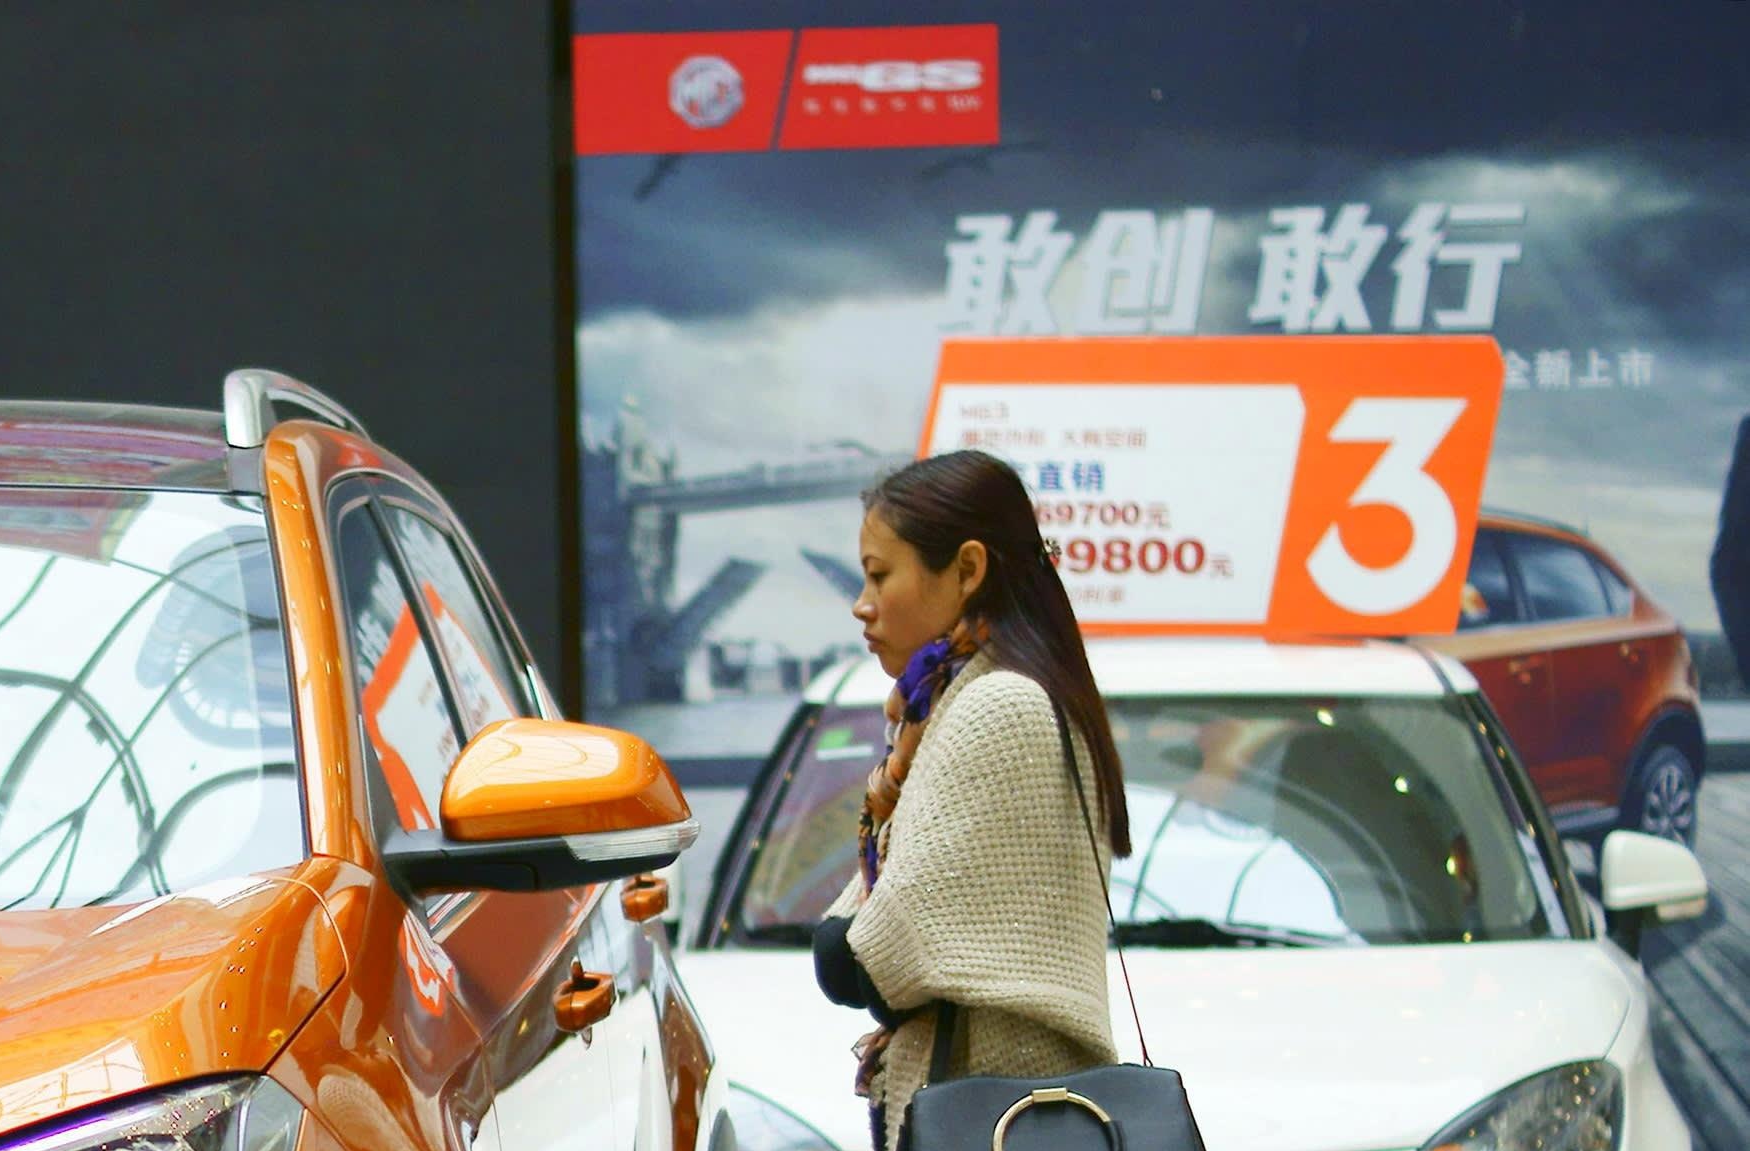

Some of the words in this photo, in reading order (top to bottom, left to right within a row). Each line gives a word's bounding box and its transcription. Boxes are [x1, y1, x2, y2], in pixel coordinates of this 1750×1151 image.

[945, 208, 1216, 334] 敢创
[1249, 202, 1527, 332] 敢行
[1305, 396, 1469, 616] 3
